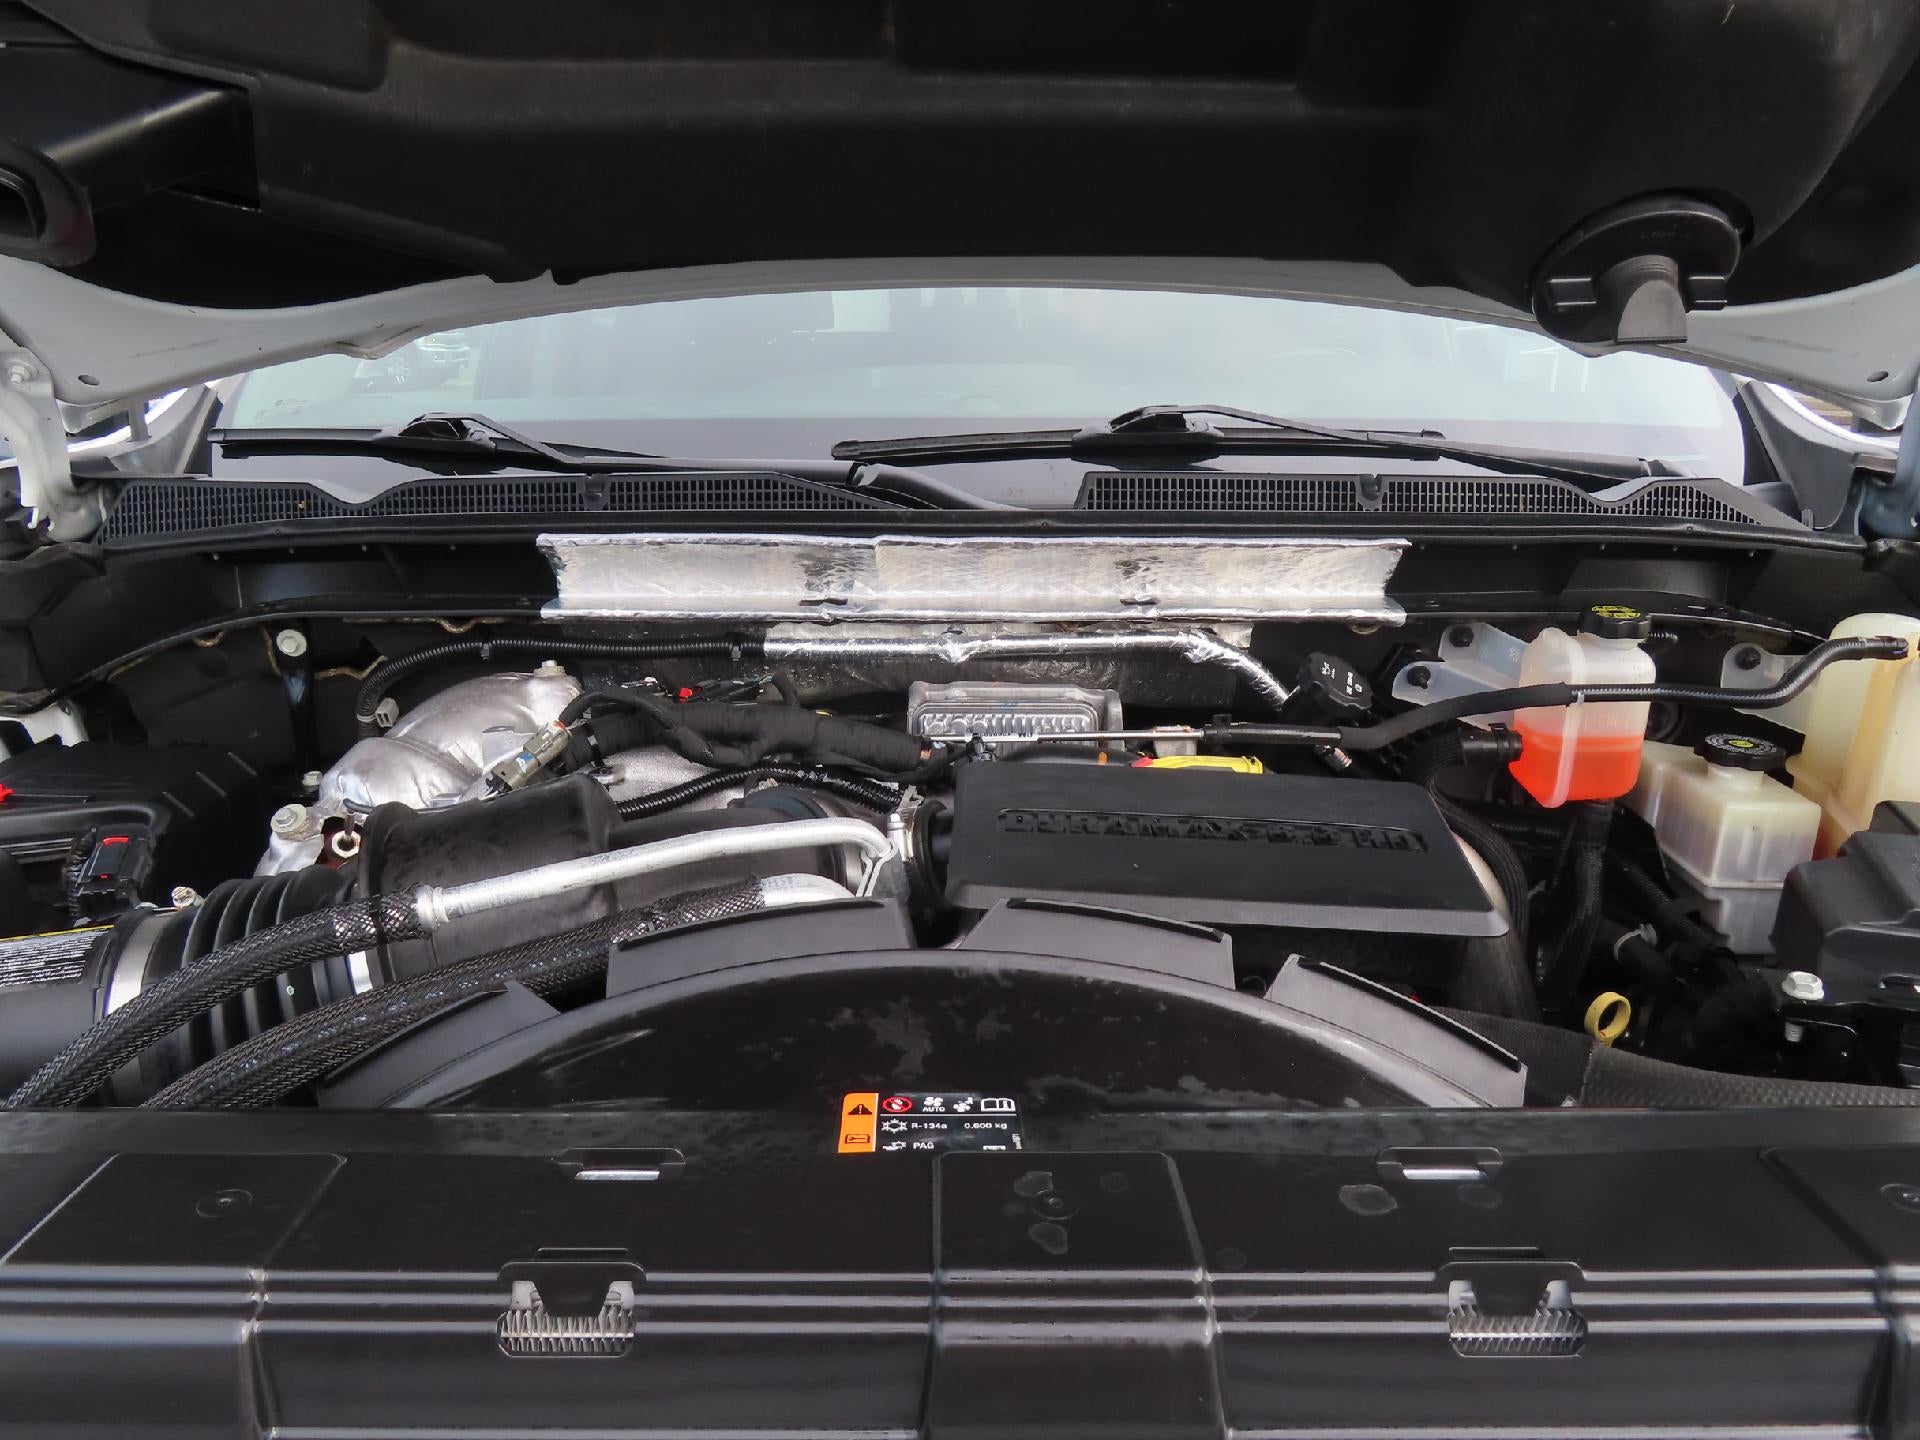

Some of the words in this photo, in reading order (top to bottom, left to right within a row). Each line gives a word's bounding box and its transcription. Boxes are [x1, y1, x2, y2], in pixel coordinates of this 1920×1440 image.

[1003, 811, 1249, 841] DURAMAX
[994, 1122, 1008, 1130] kg
[912, 1141, 935, 1150] PAG
